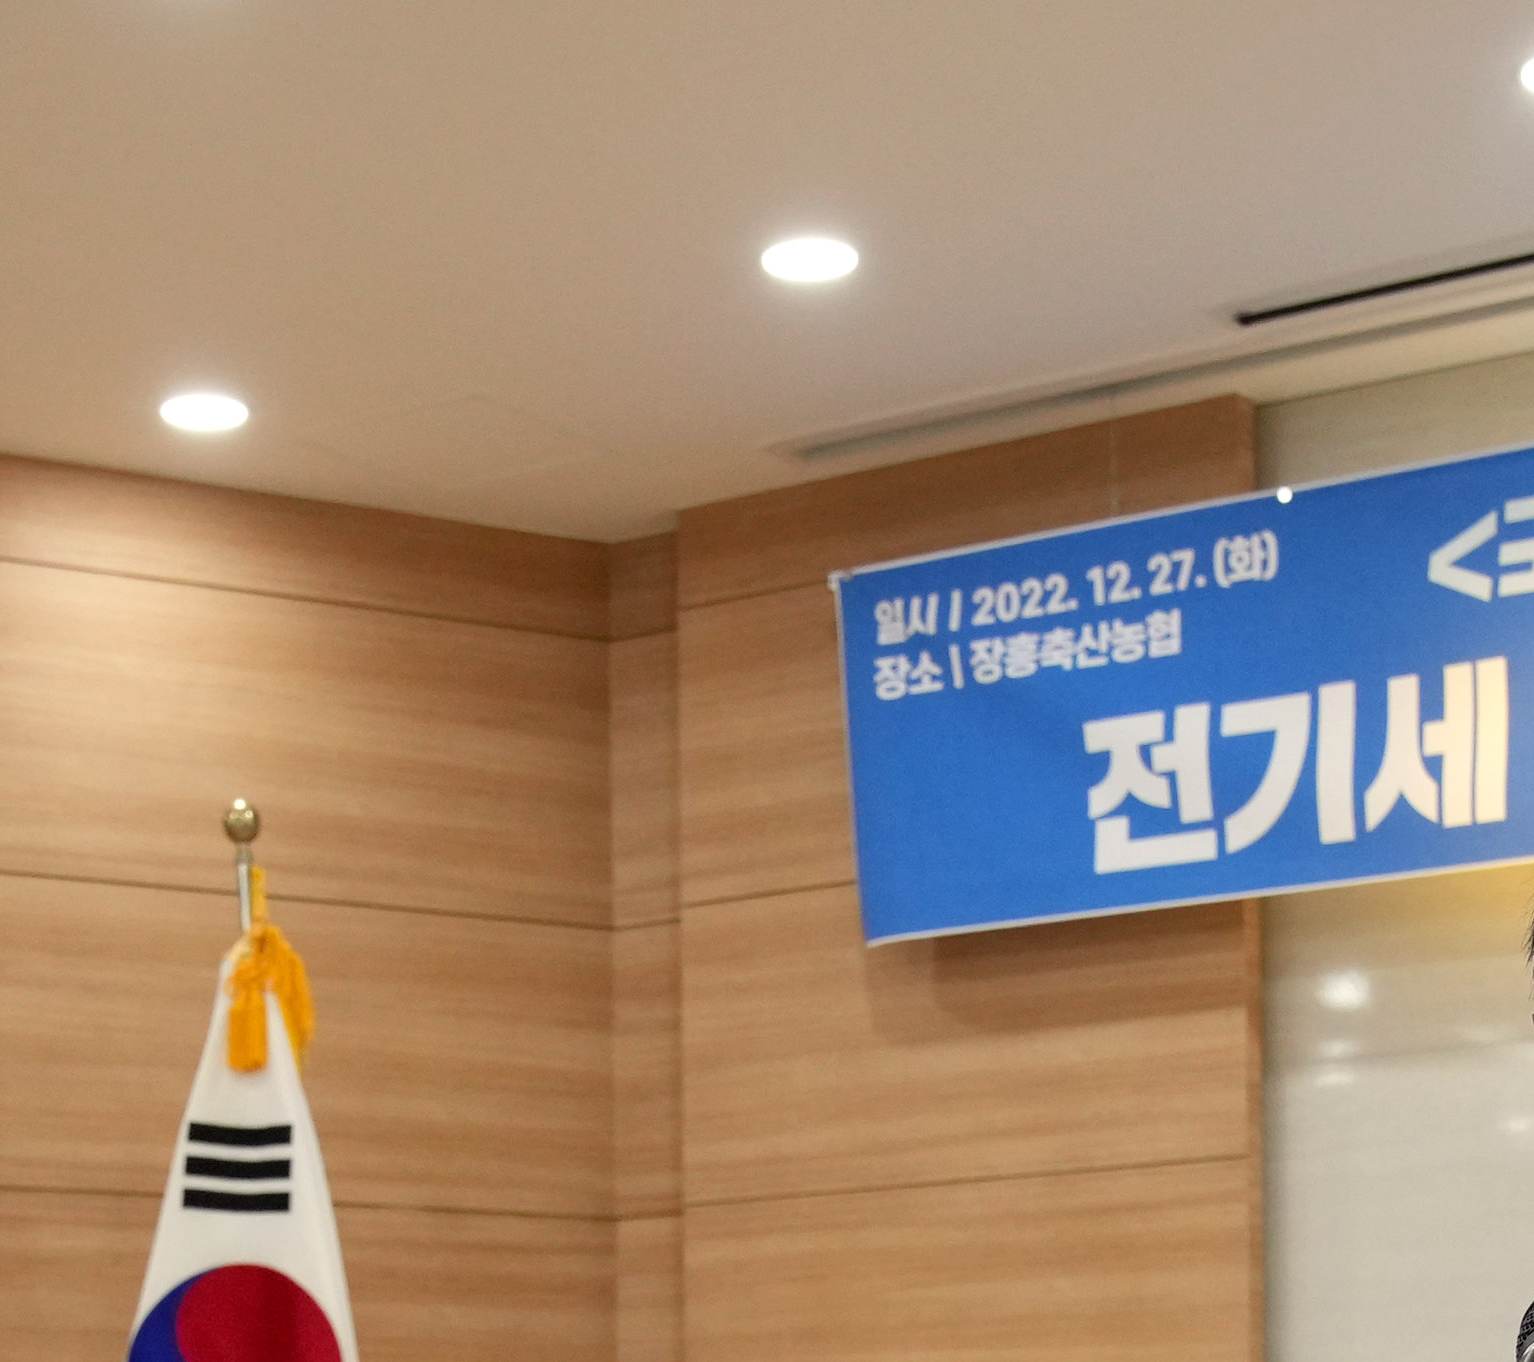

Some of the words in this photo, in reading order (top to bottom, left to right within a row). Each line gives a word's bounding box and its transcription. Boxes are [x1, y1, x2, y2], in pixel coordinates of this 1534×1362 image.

[874, 593, 939, 646] 일시
[971, 574, 1079, 627] 2022.
[1086, 560, 1143, 606] 12.
[1147, 548, 1208, 597] 27.
[1213, 529, 1279, 588] (화)
[874, 650, 945, 701] 장소
[970, 608, 1183, 685] 장흥축산농협
[1083, 655, 1511, 875] 전기세
